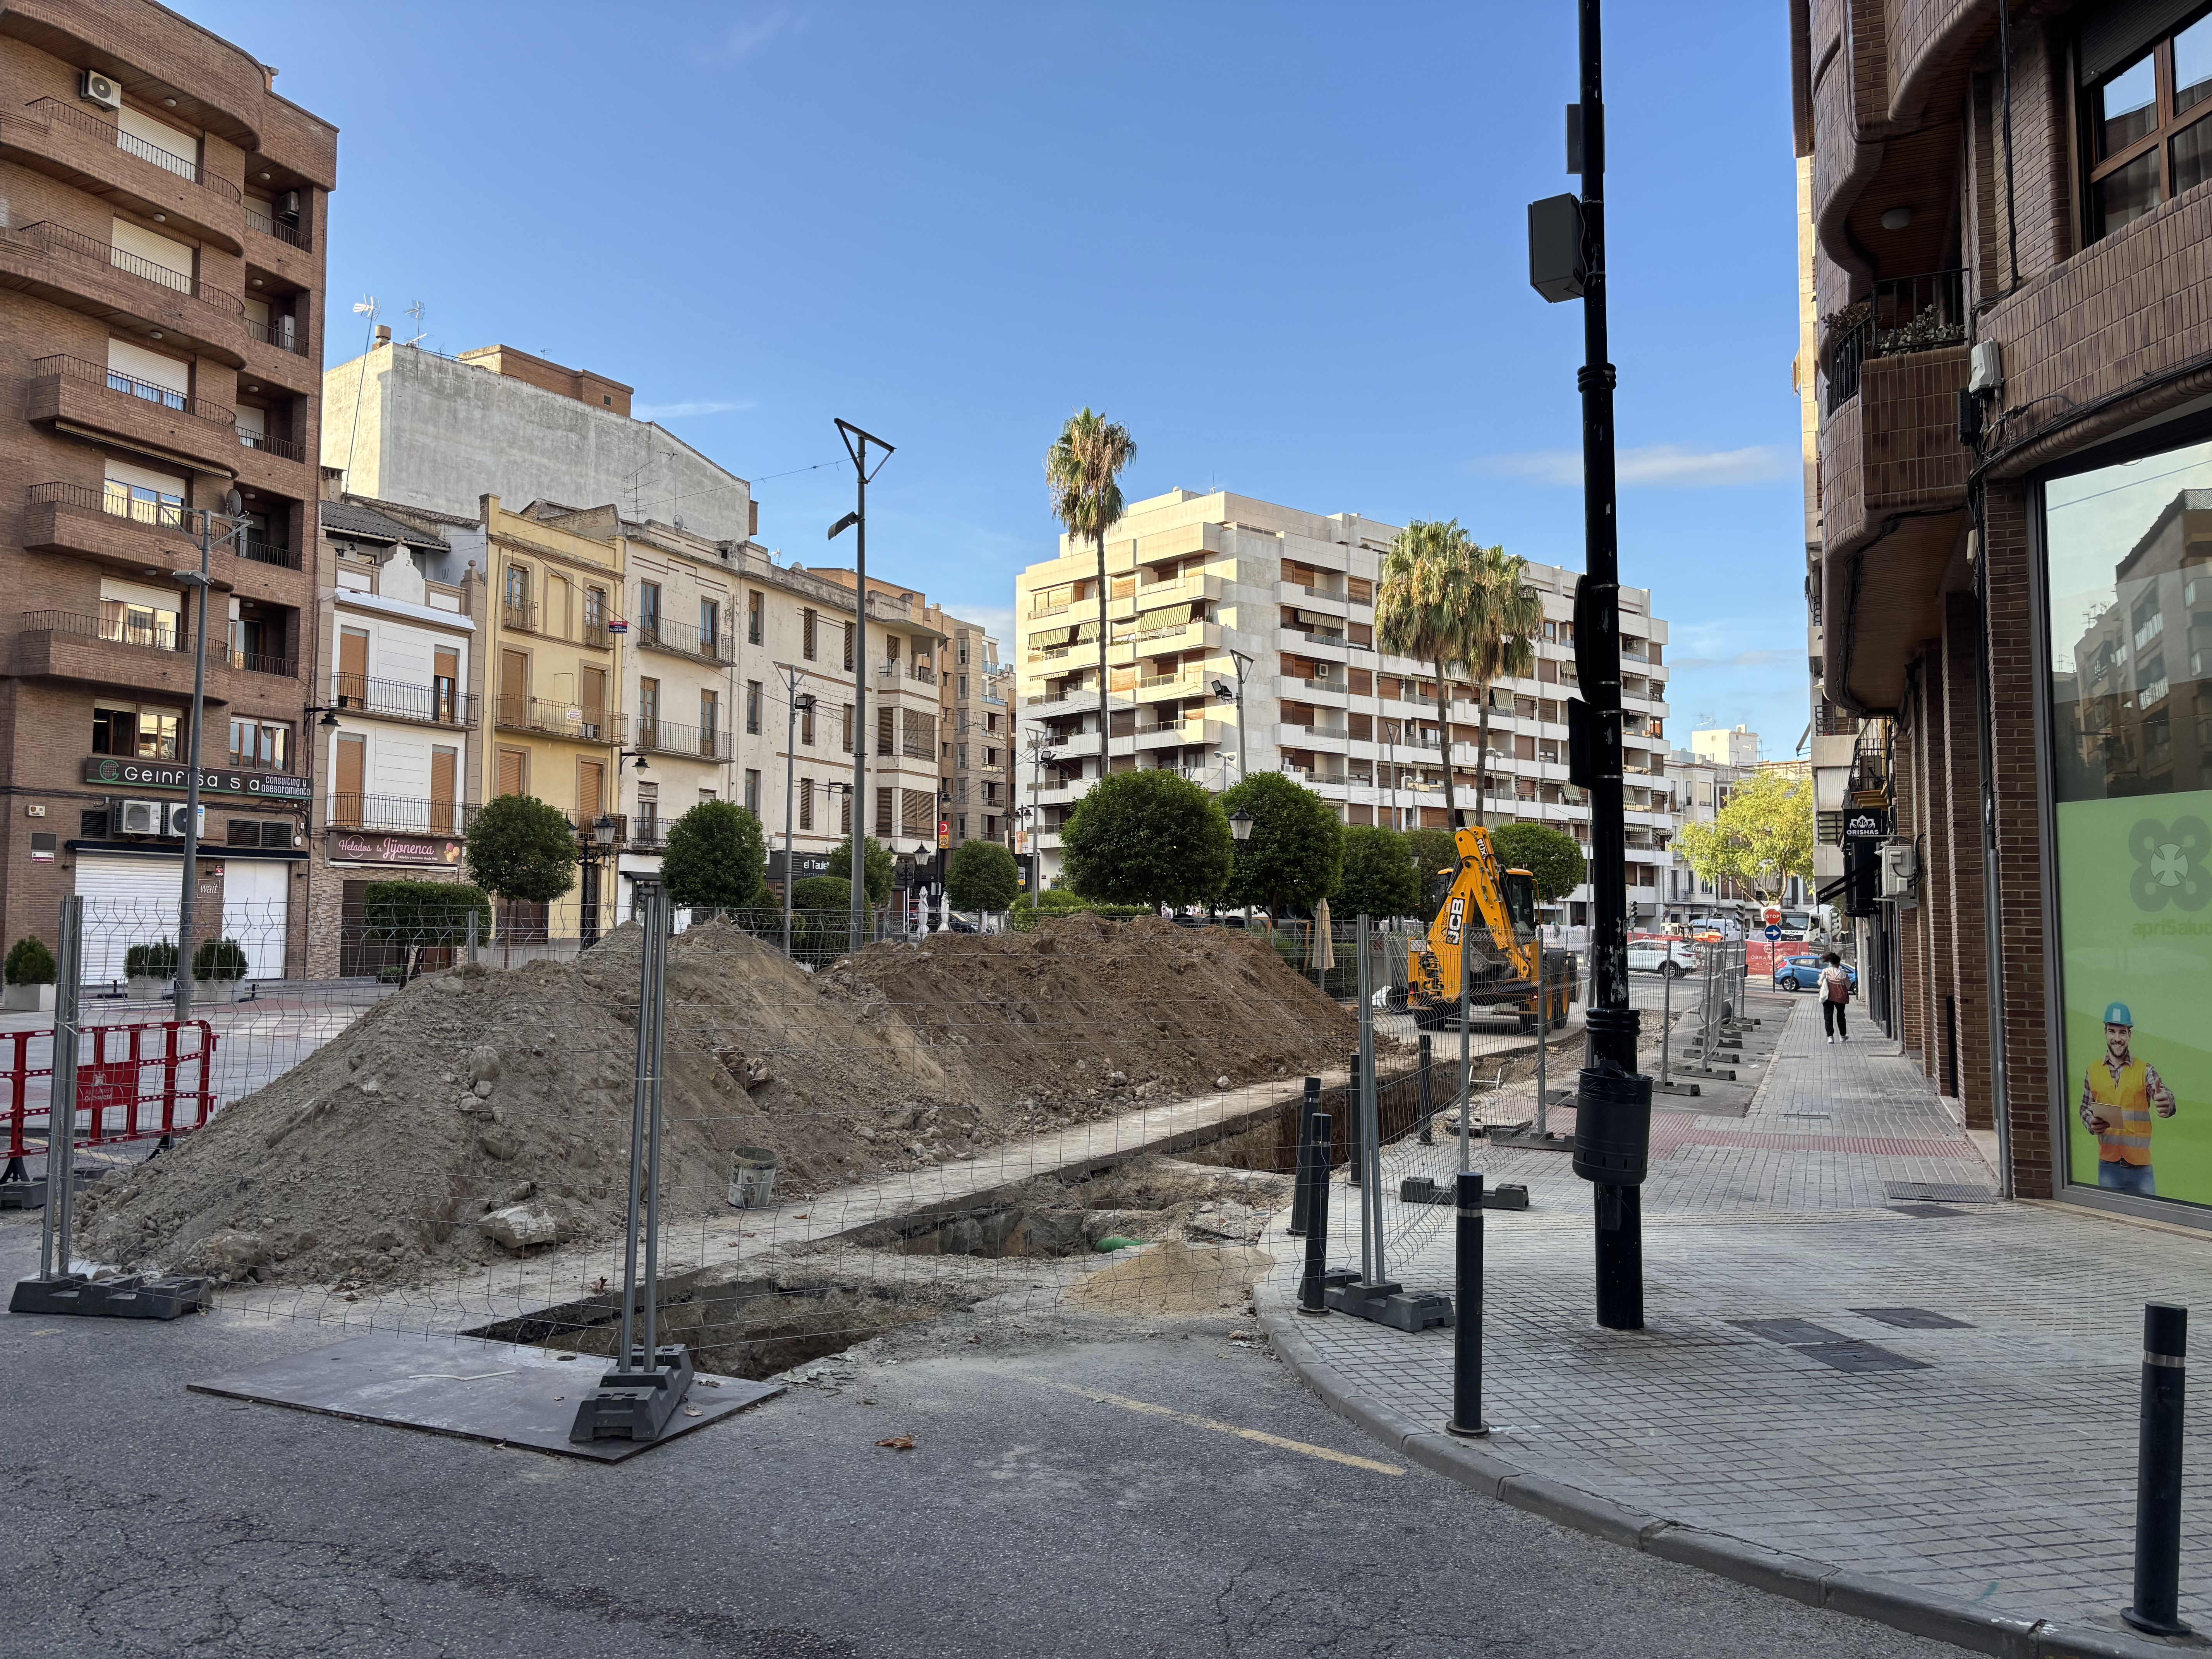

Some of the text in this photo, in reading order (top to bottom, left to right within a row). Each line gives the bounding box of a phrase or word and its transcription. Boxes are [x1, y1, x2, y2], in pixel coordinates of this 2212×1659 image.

[125, 766, 218, 787] Geinfisa
[261, 784, 310, 796] asesoramiento
[339, 839, 372, 852] Helados
[382, 837, 434, 860] Jijonenca
[804, 860, 809, 869] el
[200, 883, 218, 894] wait
[1448, 899, 1464, 944] JCB
